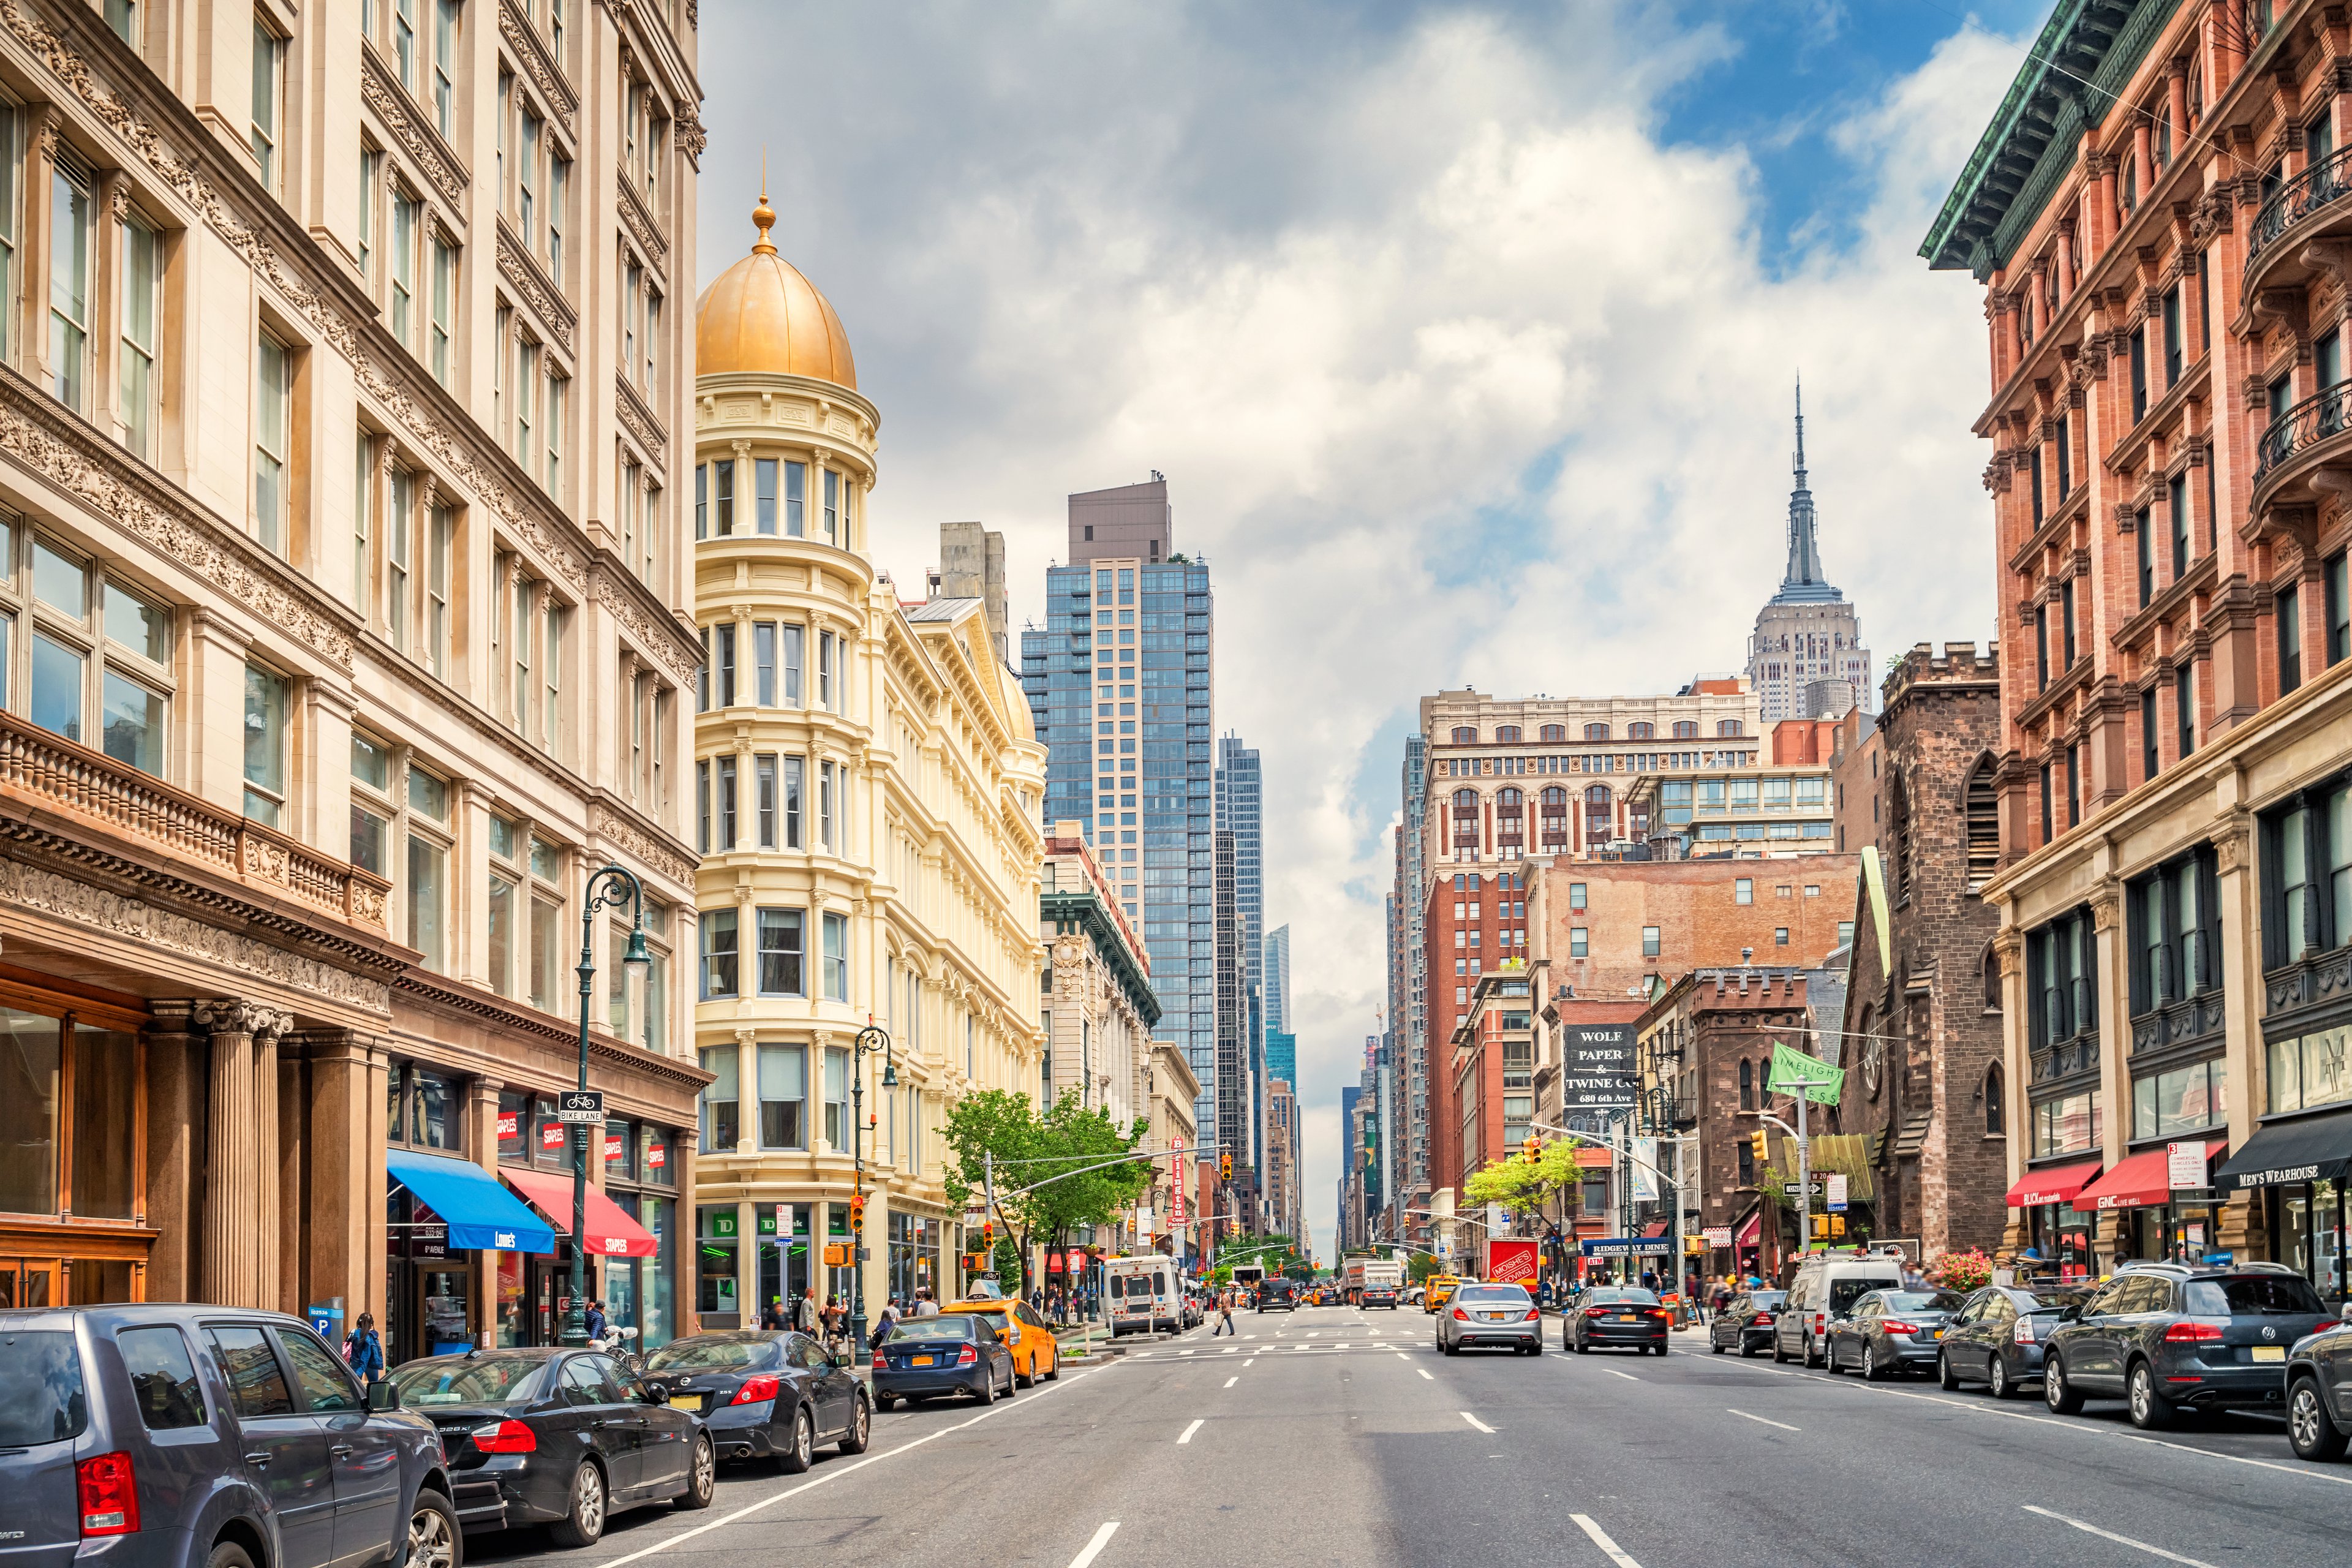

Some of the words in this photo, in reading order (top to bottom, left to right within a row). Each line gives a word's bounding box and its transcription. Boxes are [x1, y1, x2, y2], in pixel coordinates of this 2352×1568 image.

[1580, 1031, 1623, 1041] WOLF
[1579, 1050, 1623, 1060] PAPER
[1596, 1065, 1607, 1074] &
[1774, 1056, 1841, 1079] LIMELIGHT
[1566, 1078, 1613, 1088] TWINE
[1579, 1095, 1596, 1103] 680
[1597, 1094, 1612, 1102] 6th
[1769, 1080, 1837, 1104] FESS
[561, 1112, 578, 1120] BIKE
[581, 1112, 600, 1120] LANE
[544, 1128, 564, 1144] STAPLES
[605, 1141, 622, 1155] STAPLES
[2170, 1145, 2177, 1153] 3
[649, 1150, 665, 1163] STAPLES
[1172, 1140, 1183, 1216] Brlington
[2239, 1172, 2264, 1187] MEN'S
[2265, 1165, 2318, 1183] WEARHOUSE
[2024, 1192, 2039, 1205] BLICK
[2098, 1195, 2117, 1208] GNC
[2117, 1198, 2127, 1207] LIVE
[2128, 1197, 2141, 1206] WELL
[717, 1219, 733, 1232] TD
[762, 1219, 775, 1229] TD
[495, 1231, 516, 1248] LOWE'S
[605, 1238, 627, 1253] STAPLES
[1494, 1253, 1529, 1276] MOISHE'S
[1501, 1266, 1531, 1284] MOVING
[319, 1320, 328, 1334] P
